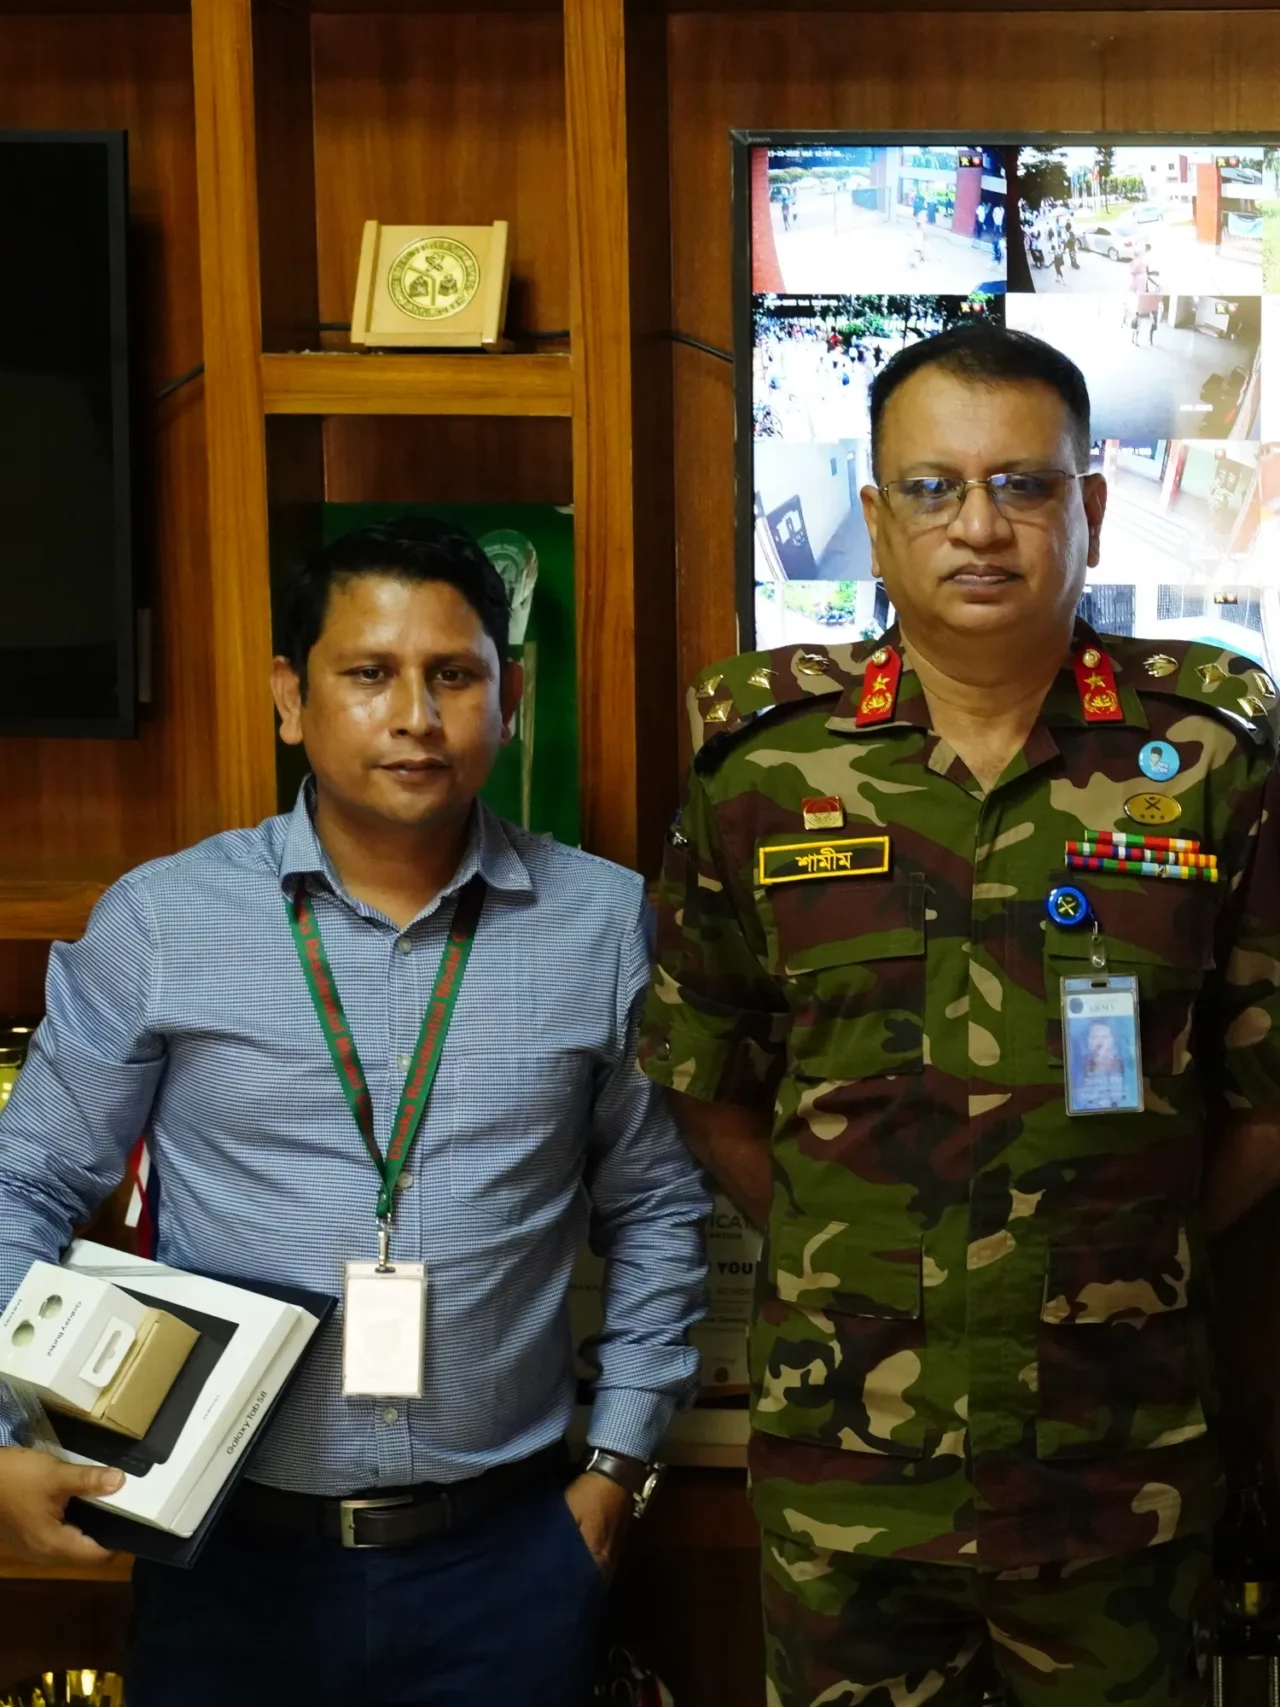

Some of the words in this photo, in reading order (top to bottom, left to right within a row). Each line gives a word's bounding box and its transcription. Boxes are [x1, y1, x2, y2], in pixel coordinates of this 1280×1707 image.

[796, 847, 853, 872] শামীম
[717, 1261, 753, 1276] YOU
[226, 1419, 252, 1455] Galaxy
[246, 1402, 260, 1422] Tab
[257, 1390, 267, 1405] S8
